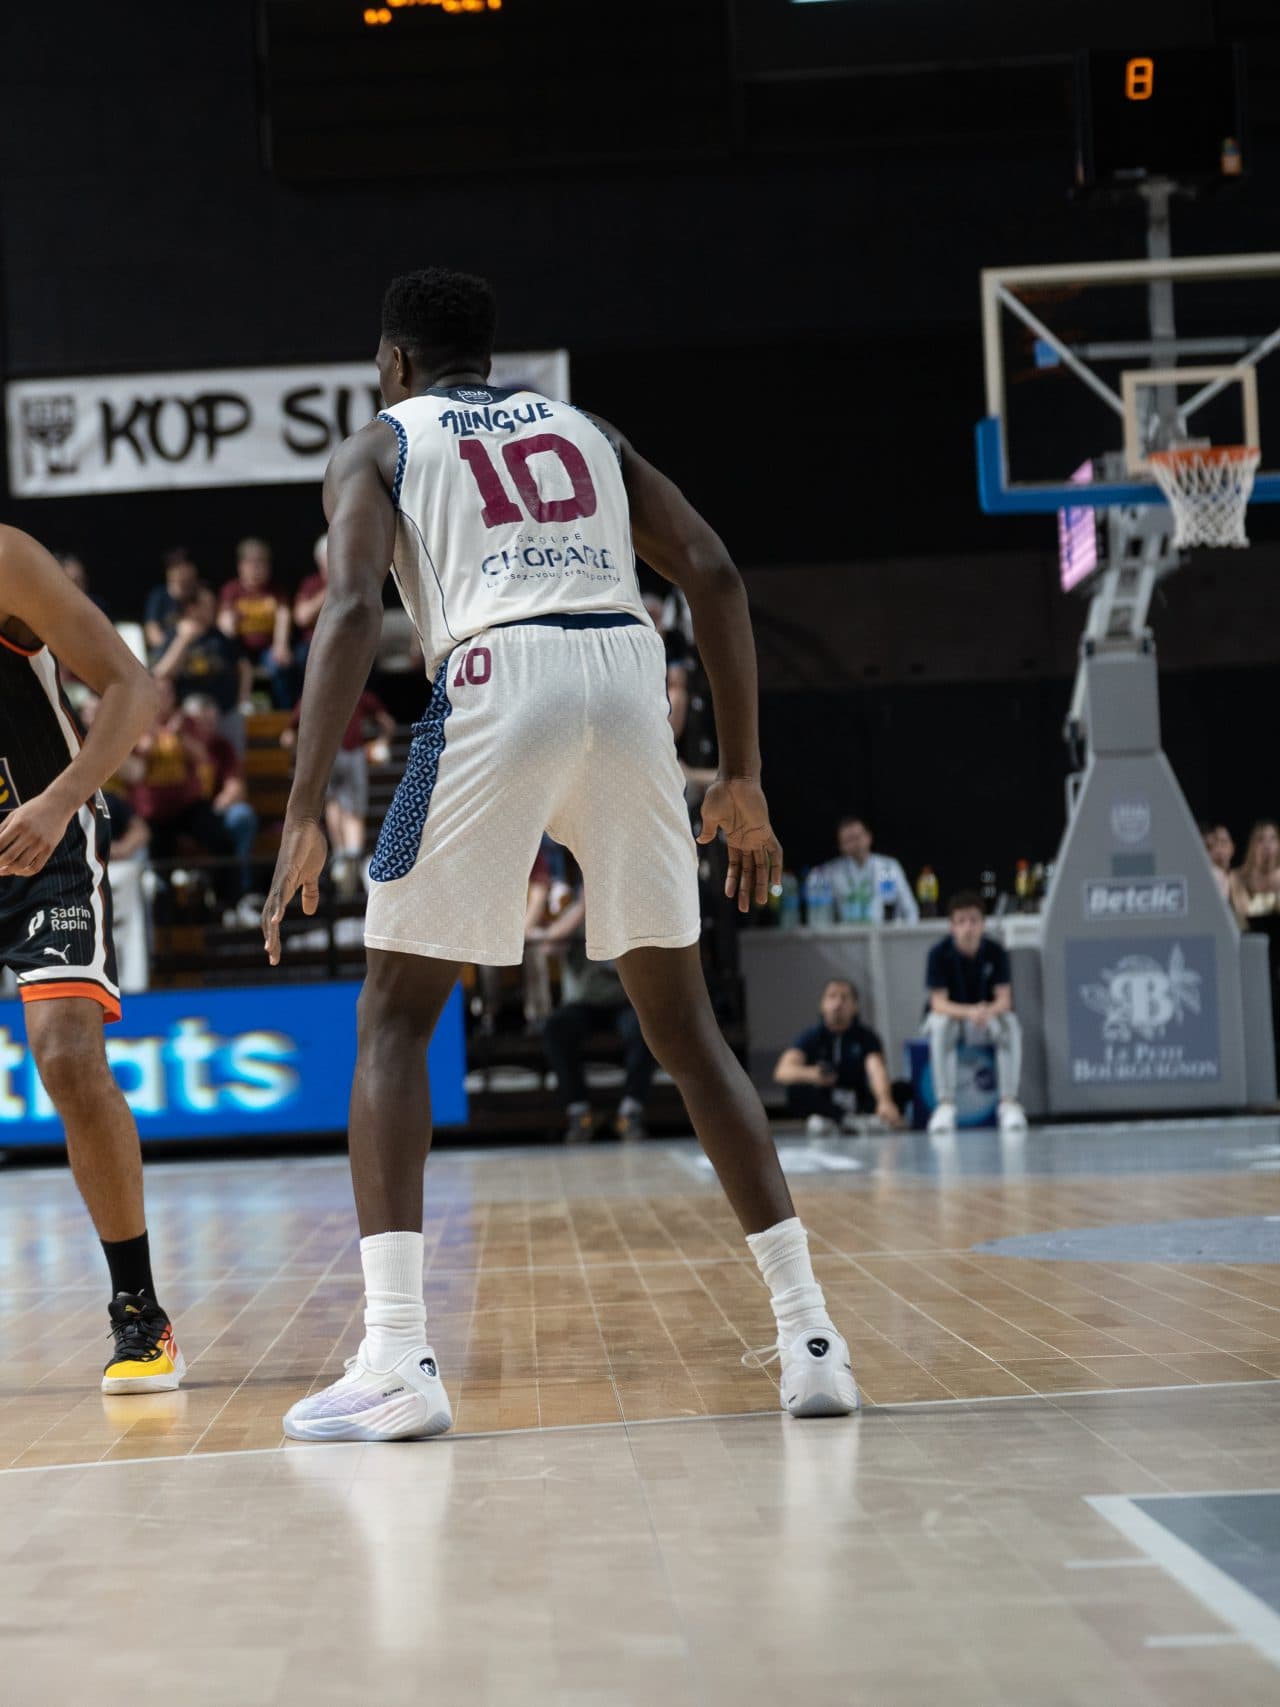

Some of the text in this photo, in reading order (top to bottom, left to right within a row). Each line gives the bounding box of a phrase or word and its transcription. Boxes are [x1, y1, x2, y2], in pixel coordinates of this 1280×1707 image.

[1125, 57, 1154, 100] 8
[100, 388, 252, 464] KOP
[458, 432, 598, 529] 10
[453, 647, 492, 688] 10
[50, 905, 91, 919] Sadrin
[1088, 884, 1181, 913] Betclic
[51, 916, 88, 932] Rapin
